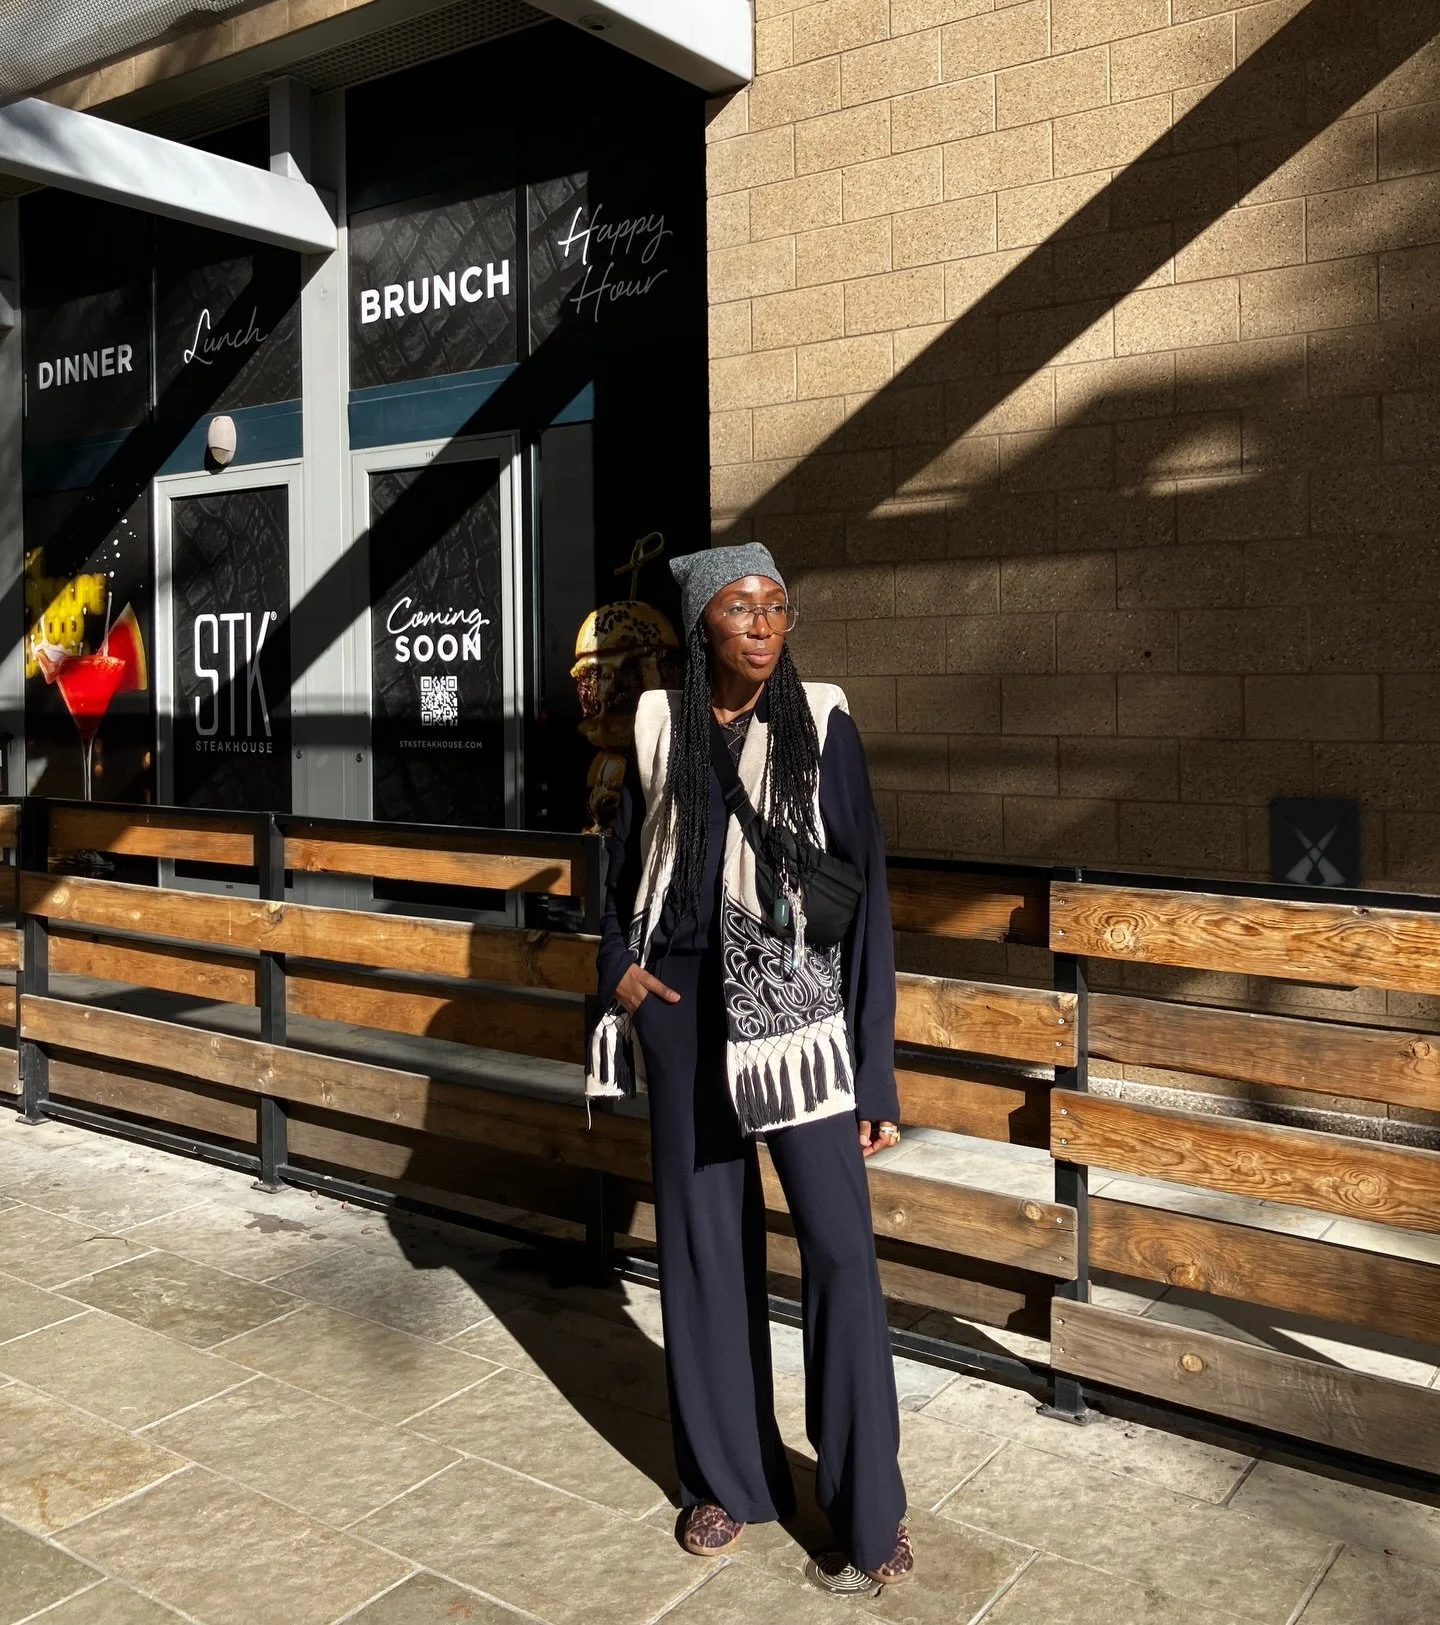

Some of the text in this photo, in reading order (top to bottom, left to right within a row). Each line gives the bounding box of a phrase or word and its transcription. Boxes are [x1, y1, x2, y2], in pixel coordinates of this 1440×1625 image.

[557, 203, 674, 266] Happy
[360, 258, 510, 325] BRUNCH
[569, 261, 668, 323] Hour
[183, 305, 269, 366] Lunch
[38, 343, 134, 390] DINNER
[386, 596, 490, 644] Coming
[395, 633, 482, 663] SOON
[195, 740, 273, 754] STEAKHOUSE
[399, 740, 483, 749] STKSTEAKHOUSE.COM
